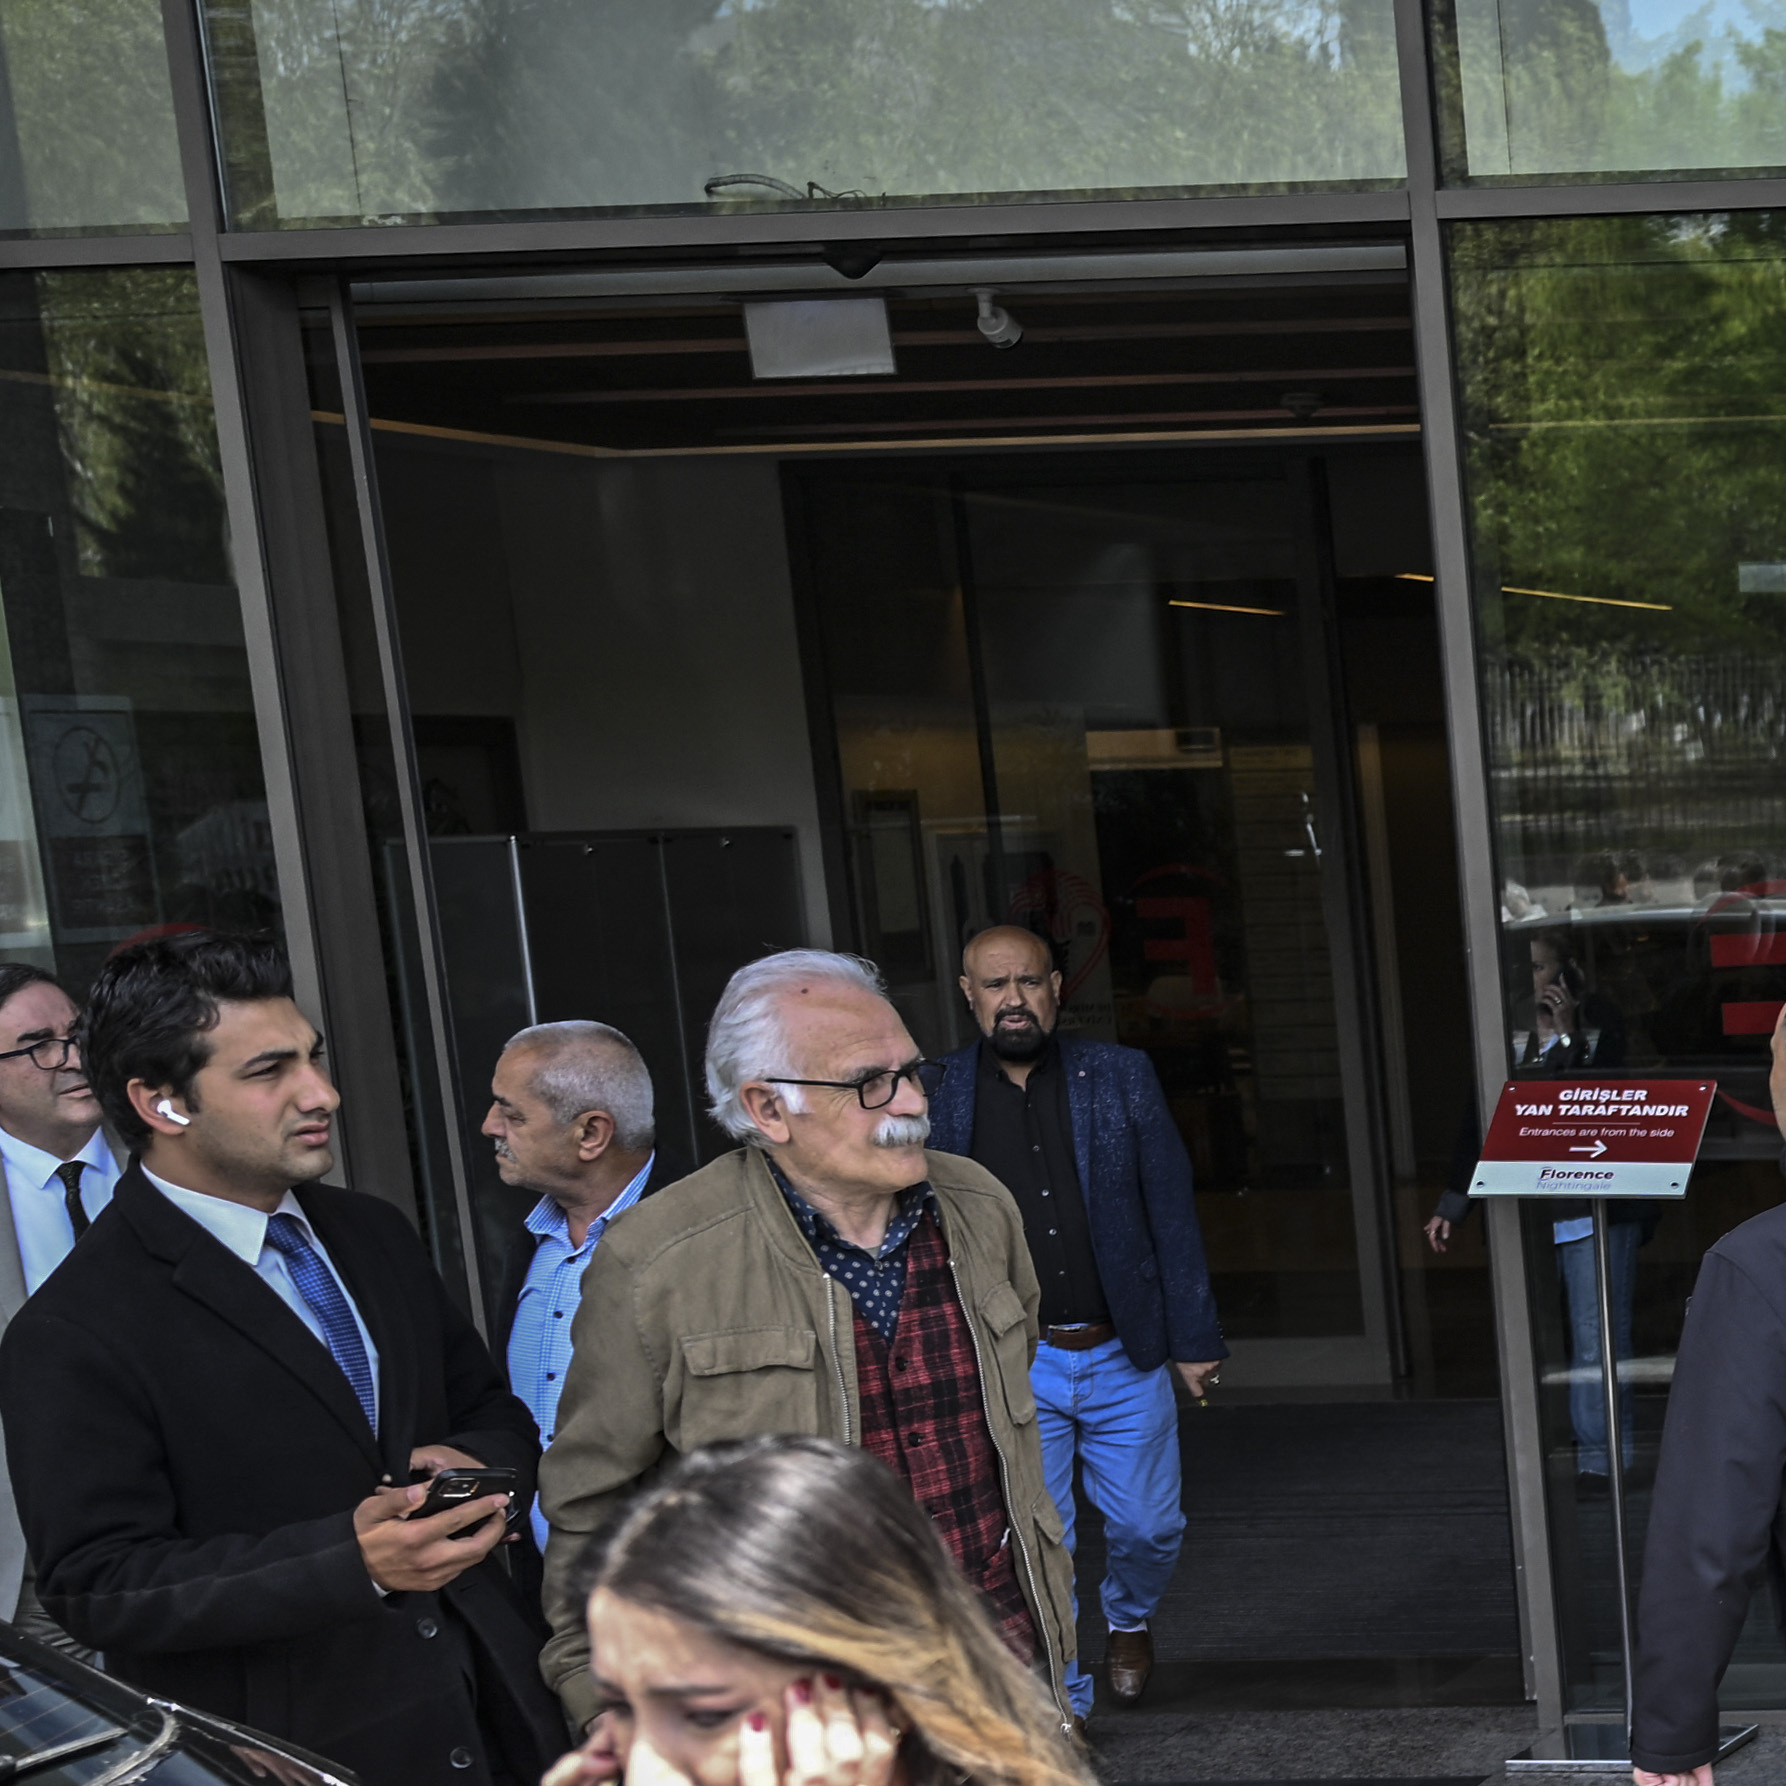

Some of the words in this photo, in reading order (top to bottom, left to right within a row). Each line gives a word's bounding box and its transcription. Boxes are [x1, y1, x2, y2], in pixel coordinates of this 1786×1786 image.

[1558, 1087, 1648, 1104] GİRİŞLER
[1515, 1104, 1553, 1117] YAN
[1558, 1104, 1689, 1117] TARAFTANDIR
[1519, 1126, 1576, 1138] Entrances
[1579, 1129, 1598, 1137] are
[1600, 1127, 1627, 1138] from
[1629, 1127, 1648, 1138] the
[1650, 1127, 1675, 1138] side
[1540, 1167, 1614, 1181] Florence
[1536, 1180, 1612, 1192] Nightingale
